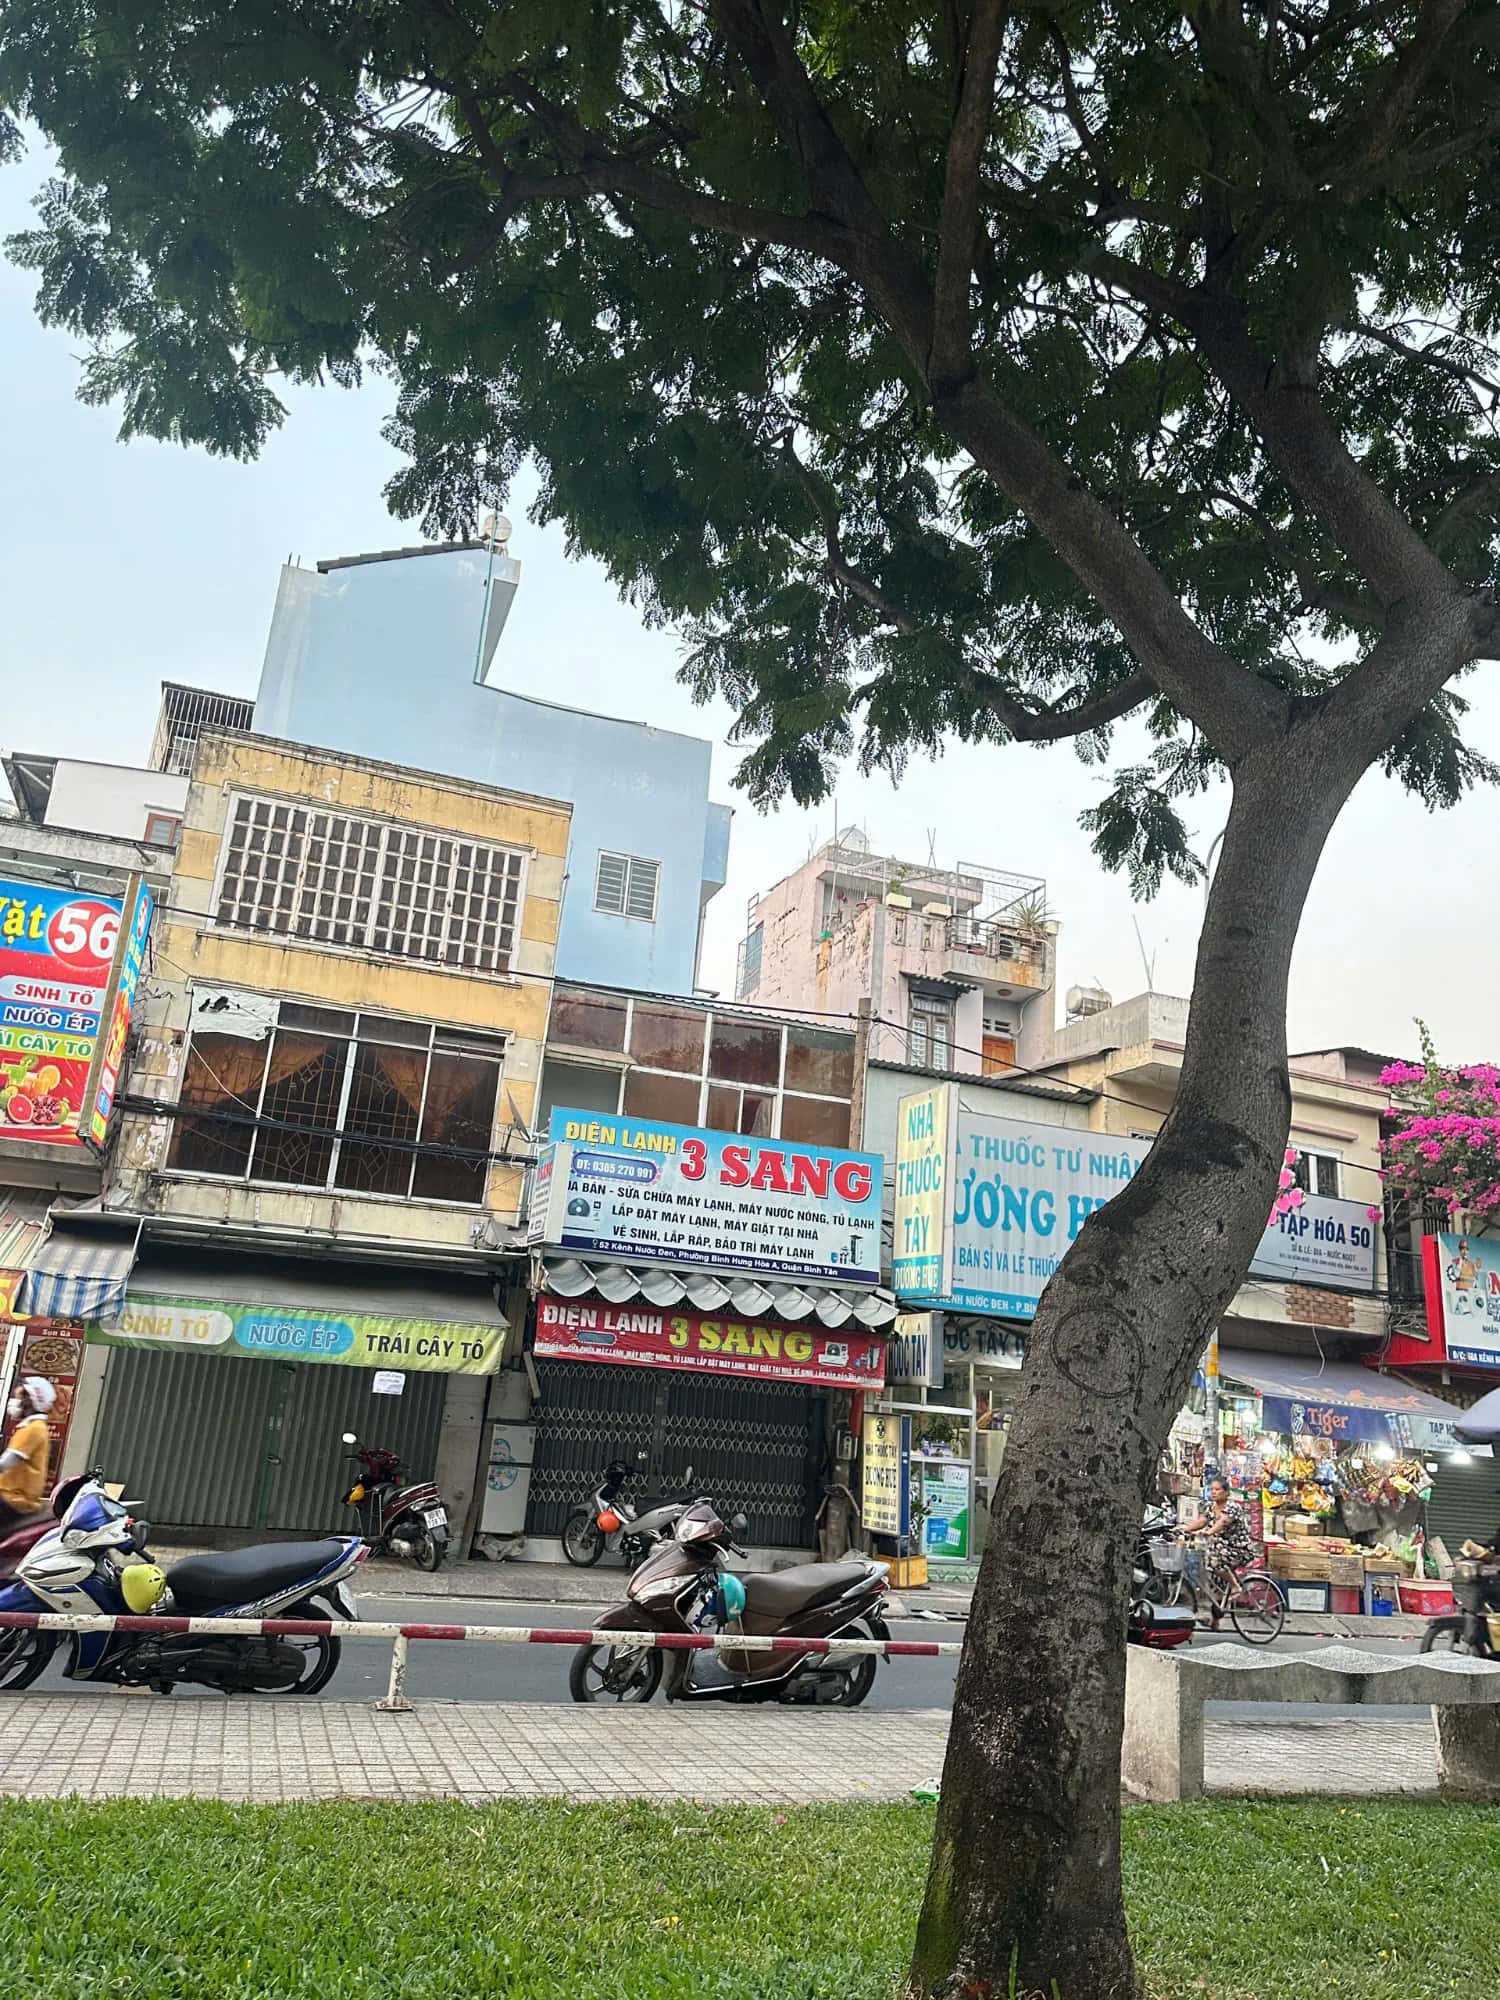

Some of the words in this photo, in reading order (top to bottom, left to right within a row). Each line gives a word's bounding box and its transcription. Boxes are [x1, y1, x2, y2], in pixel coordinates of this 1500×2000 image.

[54, 906, 121, 960] 56
[14, 983, 61, 1001] SINH
[68, 988, 96, 1006] TỐ
[5, 1005, 61, 1027] NƯỚC
[66, 1012, 95, 1031] ÉP
[19, 1033, 59, 1052] CÂY
[66, 1039, 92, 1057] TÔ
[908, 1095, 934, 1141] NHÀ
[565, 1121, 616, 1147] ĐIỆN
[622, 1128, 677, 1154] LẠNH
[680, 1137, 708, 1181] 3
[720, 1144, 873, 1202] SANG
[617, 1164, 635, 1177] 270
[636, 1166, 653, 1179] 991
[898, 1142, 942, 1197] THUỐC
[970, 1135, 1046, 1168] THUỐC
[1052, 1146, 1081, 1172] TƯ
[582, 1180, 606, 1194] BÁN
[617, 1185, 640, 1200] SỬA
[643, 1189, 673, 1204] CHỮA
[676, 1193, 700, 1207] MÁY
[739, 1202, 762, 1217] MÁY
[765, 1205, 794, 1220] NƯỚC
[833, 1213, 845, 1226] TỦ
[848, 1217, 875, 1231] LẠNH
[954, 1167, 1057, 1237] ƯƠNG
[613, 1223, 627, 1238] VỆ
[740, 1239, 757, 1252] TRÌ
[760, 1242, 784, 1256] MÁY
[787, 1246, 814, 1260] LẠNH
[661, 1211, 685, 1224] MÁY
[724, 1218, 748, 1232] MÁY
[778, 1227, 794, 1239] TẠI
[797, 1227, 819, 1241] NHÀ
[904, 1207, 930, 1253] TÂY
[1279, 1211, 1309, 1242] TẠP
[1314, 1216, 1346, 1244] HÓA
[1351, 1225, 1370, 1248] 50
[599, 1241, 609, 1250] 52
[959, 1244, 981, 1269] BÁN
[996, 1247, 1009, 1272] VÀ
[182, 1312, 213, 1339] TỐ
[248, 1320, 305, 1348] NƯỚC
[310, 1325, 338, 1351] ÉP
[366, 1331, 410, 1355] TRÁI
[415, 1335, 454, 1358] CÂY
[461, 1337, 485, 1360] TÔ
[543, 1303, 597, 1330] ĐIỆN
[604, 1311, 662, 1335] LẠNH
[668, 1316, 690, 1348] 3
[698, 1320, 814, 1362] SANG
[1307, 1406, 1349, 1436] Tiger
[1429, 1421, 1444, 1438] TẠP
